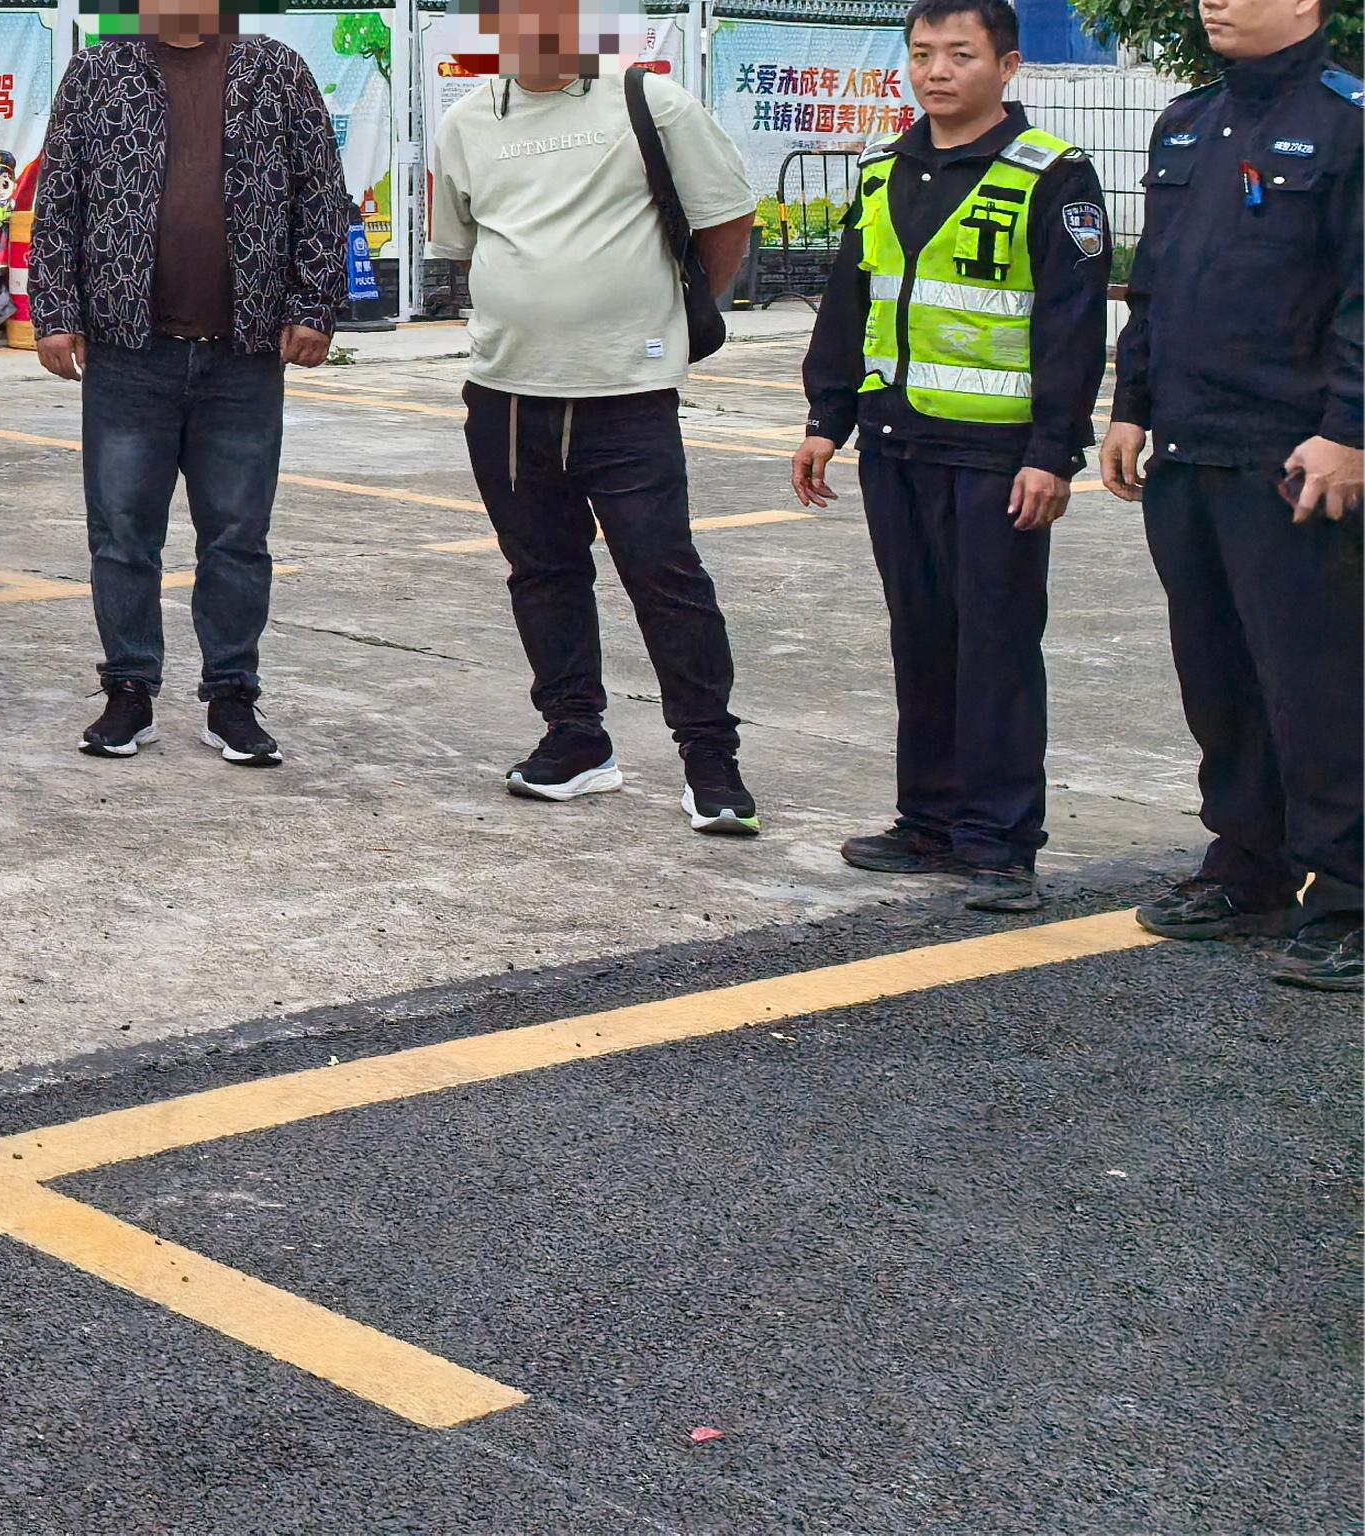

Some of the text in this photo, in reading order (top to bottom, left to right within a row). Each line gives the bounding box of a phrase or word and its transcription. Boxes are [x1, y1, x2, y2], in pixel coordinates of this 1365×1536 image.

[736, 64, 902, 99] 关爱未成年人成长
[752, 101, 916, 133] 共铸祖国美好未来
[500, 131, 605, 159] AUTNEHTIC
